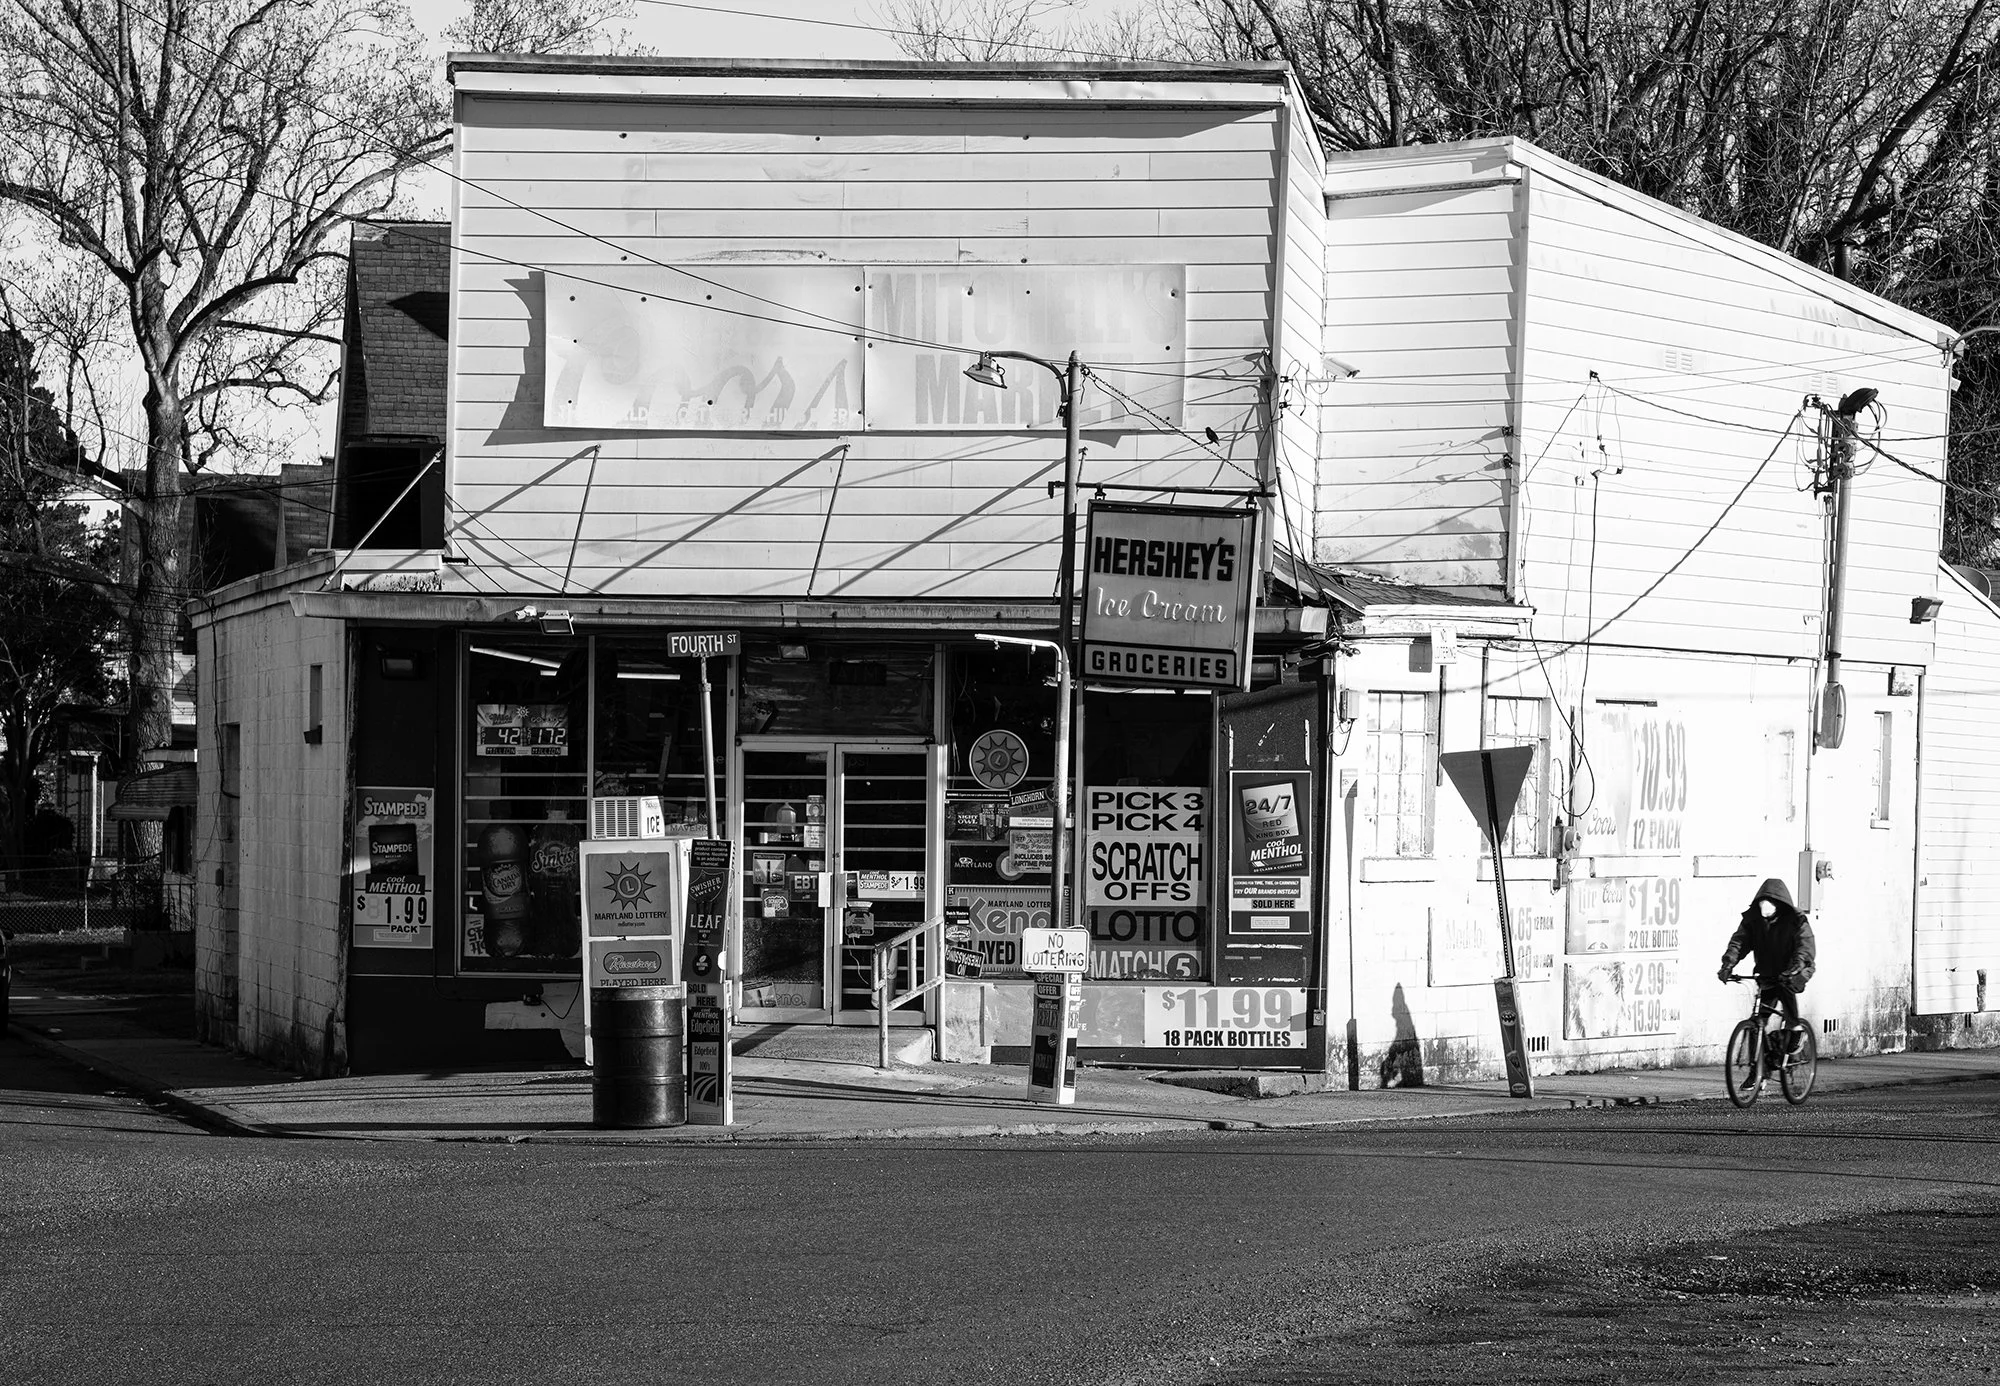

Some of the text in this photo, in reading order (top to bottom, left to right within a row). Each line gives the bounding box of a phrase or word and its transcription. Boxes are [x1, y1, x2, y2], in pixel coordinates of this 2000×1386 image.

[1094, 536, 1235, 582] HERSHEY'S
[1097, 586, 1227, 623] Ice Cream
[671, 634, 737, 654] FOURTH ST
[1092, 650, 1228, 679] GROCERIES
[498, 728, 520, 744] 42
[538, 728, 566, 744] 172
[364, 796, 427, 816] STAMPEDE
[1011, 791, 1045, 806] LONGHORN
[1092, 792, 1205, 811] PICK 3
[1245, 795, 1291, 815] 24/7
[646, 814, 660, 834] ICE
[1092, 813, 1204, 831] PICK 4
[1262, 820, 1282, 828] RED
[1256, 829, 1291, 839] KING BOX
[1633, 818, 1682, 850] 12 PACK
[372, 841, 413, 854] STAMPEDE
[1266, 838, 1285, 848] cool
[1250, 843, 1303, 861] MENTHOL
[1091, 841, 1203, 881] SCRATCH
[386, 875, 406, 883] cool
[501, 880, 517, 891] DRY
[690, 877, 722, 894] SWISHER
[794, 875, 818, 890] EBT
[859, 880, 888, 890] STAMPEDE
[904, 876, 925, 891] 1.99
[369, 882, 422, 894] MENTHOL
[1104, 882, 1191, 901] OFFS
[1244, 887, 1258, 895] OUR
[357, 895, 428, 924] $ 1.99
[987, 900, 1024, 908] MARYLAND
[1252, 900, 1294, 908] SOLD HERE
[1629, 877, 1681, 927] $1.39
[594, 911, 667, 920] MARYLAND LOTTERY
[690, 914, 722, 929] LEAF
[390, 925, 418, 933] PACK
[1090, 910, 1201, 942] LOTTO
[1047, 934, 1064, 949] NO
[1629, 932, 1639, 949] 22
[1652, 929, 1679, 948] BOTTLES
[1026, 951, 1084, 967] LOITERING
[1089, 950, 1190, 979] MATCH 5
[640, 978, 667, 986] HERE
[1036, 974, 1064, 983] SPECIAL
[1629, 962, 1665, 996] $2.99
[688, 983, 707, 993] SOLD
[1038, 985, 1057, 994] OFFER
[696, 996, 716, 1007] HERE
[1161, 988, 1292, 1029] $11.99
[1628, 998, 1661, 1033] $15.99
[691, 1020, 720, 1034] Edgefield
[1163, 1030, 1291, 1047] 18 PACK BOTTLES
[694, 1046, 717, 1056] Edgefield
